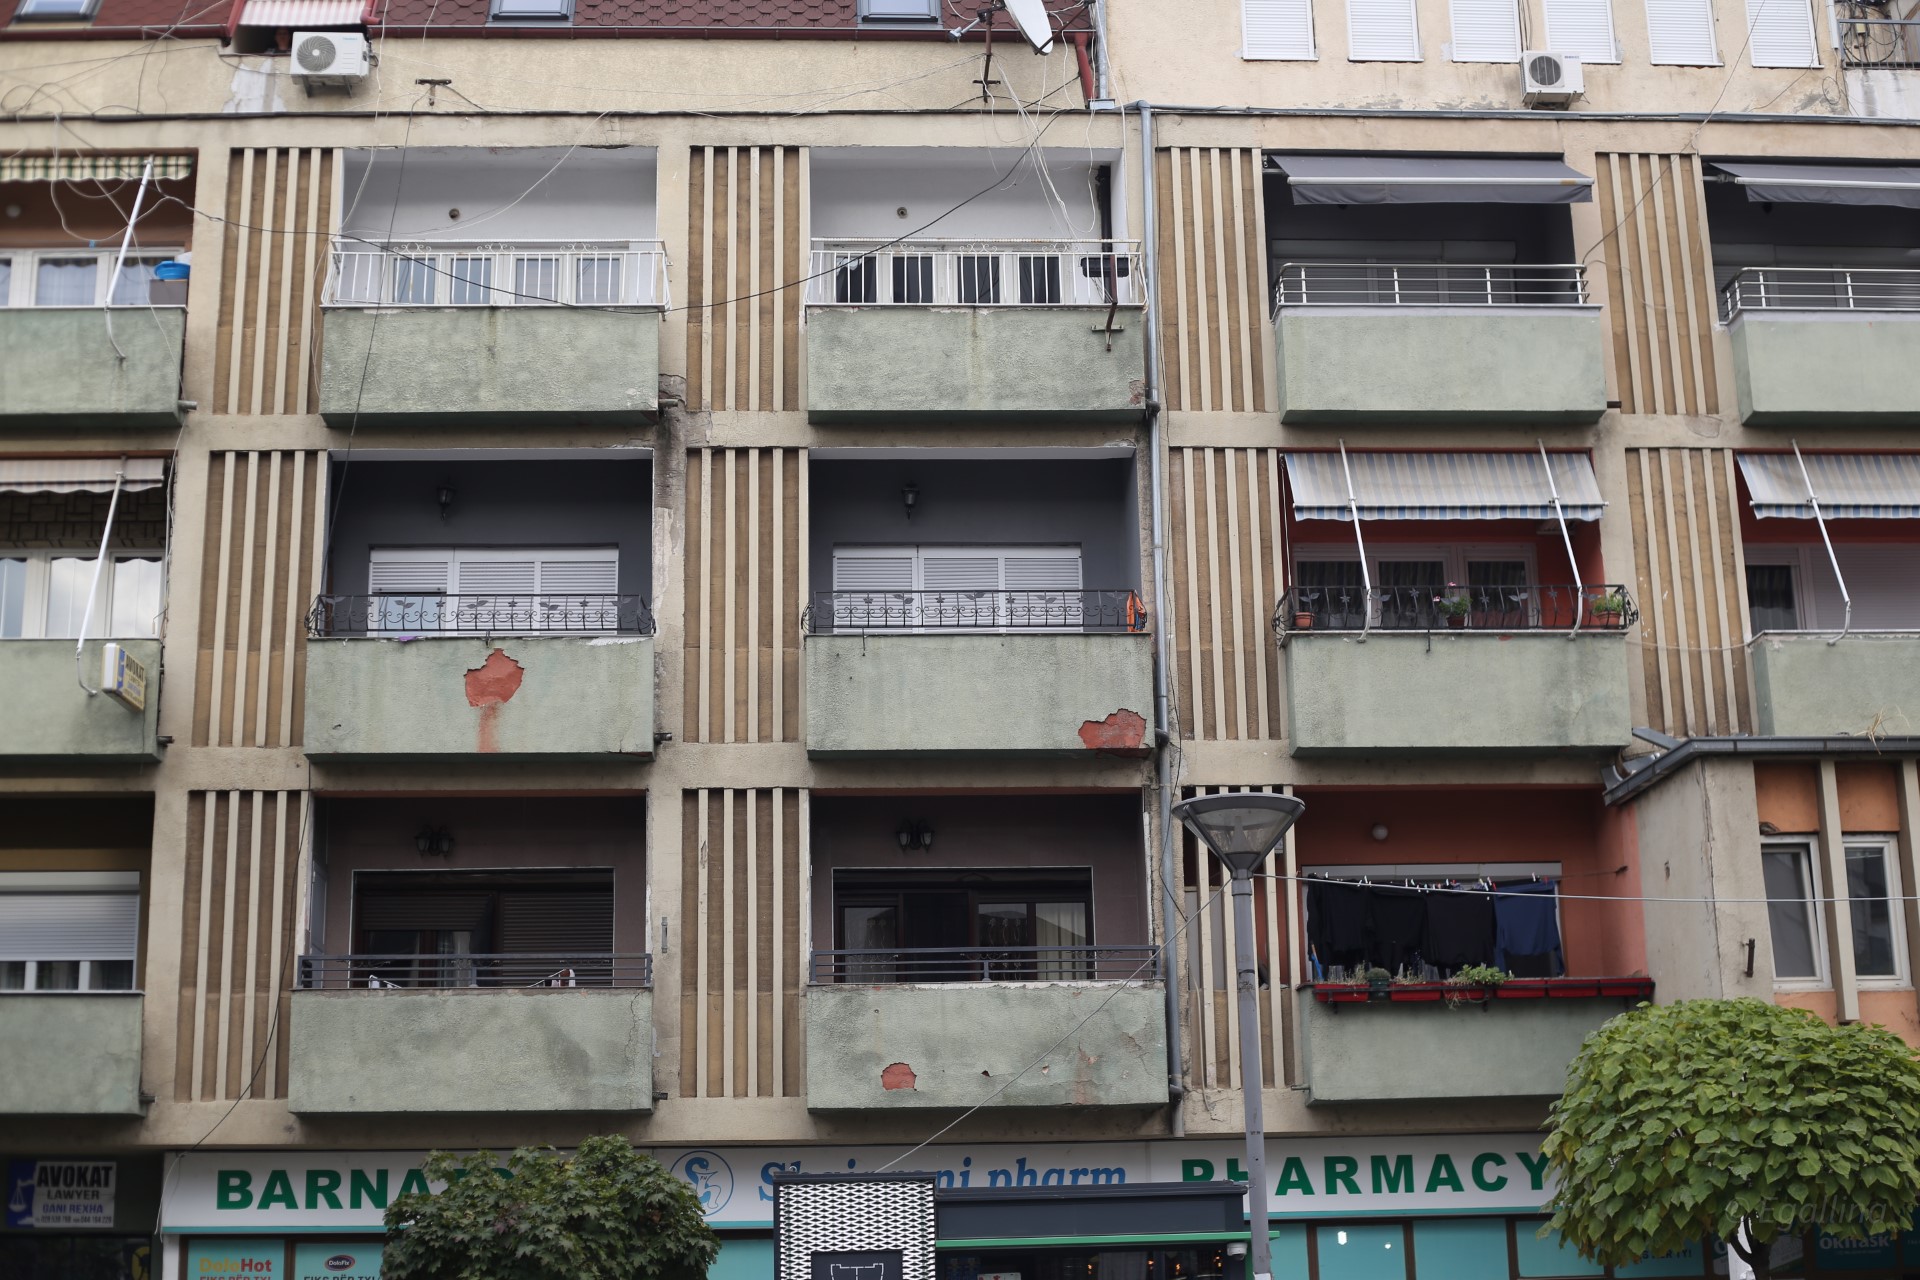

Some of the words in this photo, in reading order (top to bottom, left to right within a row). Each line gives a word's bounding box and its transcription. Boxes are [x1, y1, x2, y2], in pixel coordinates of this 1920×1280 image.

[37, 1165, 113, 1187] AVOKAT
[47, 1189, 99, 1200] LAWYER
[69, 1203, 104, 1213] REXHA
[199, 1257, 272, 1273] DoloHot
